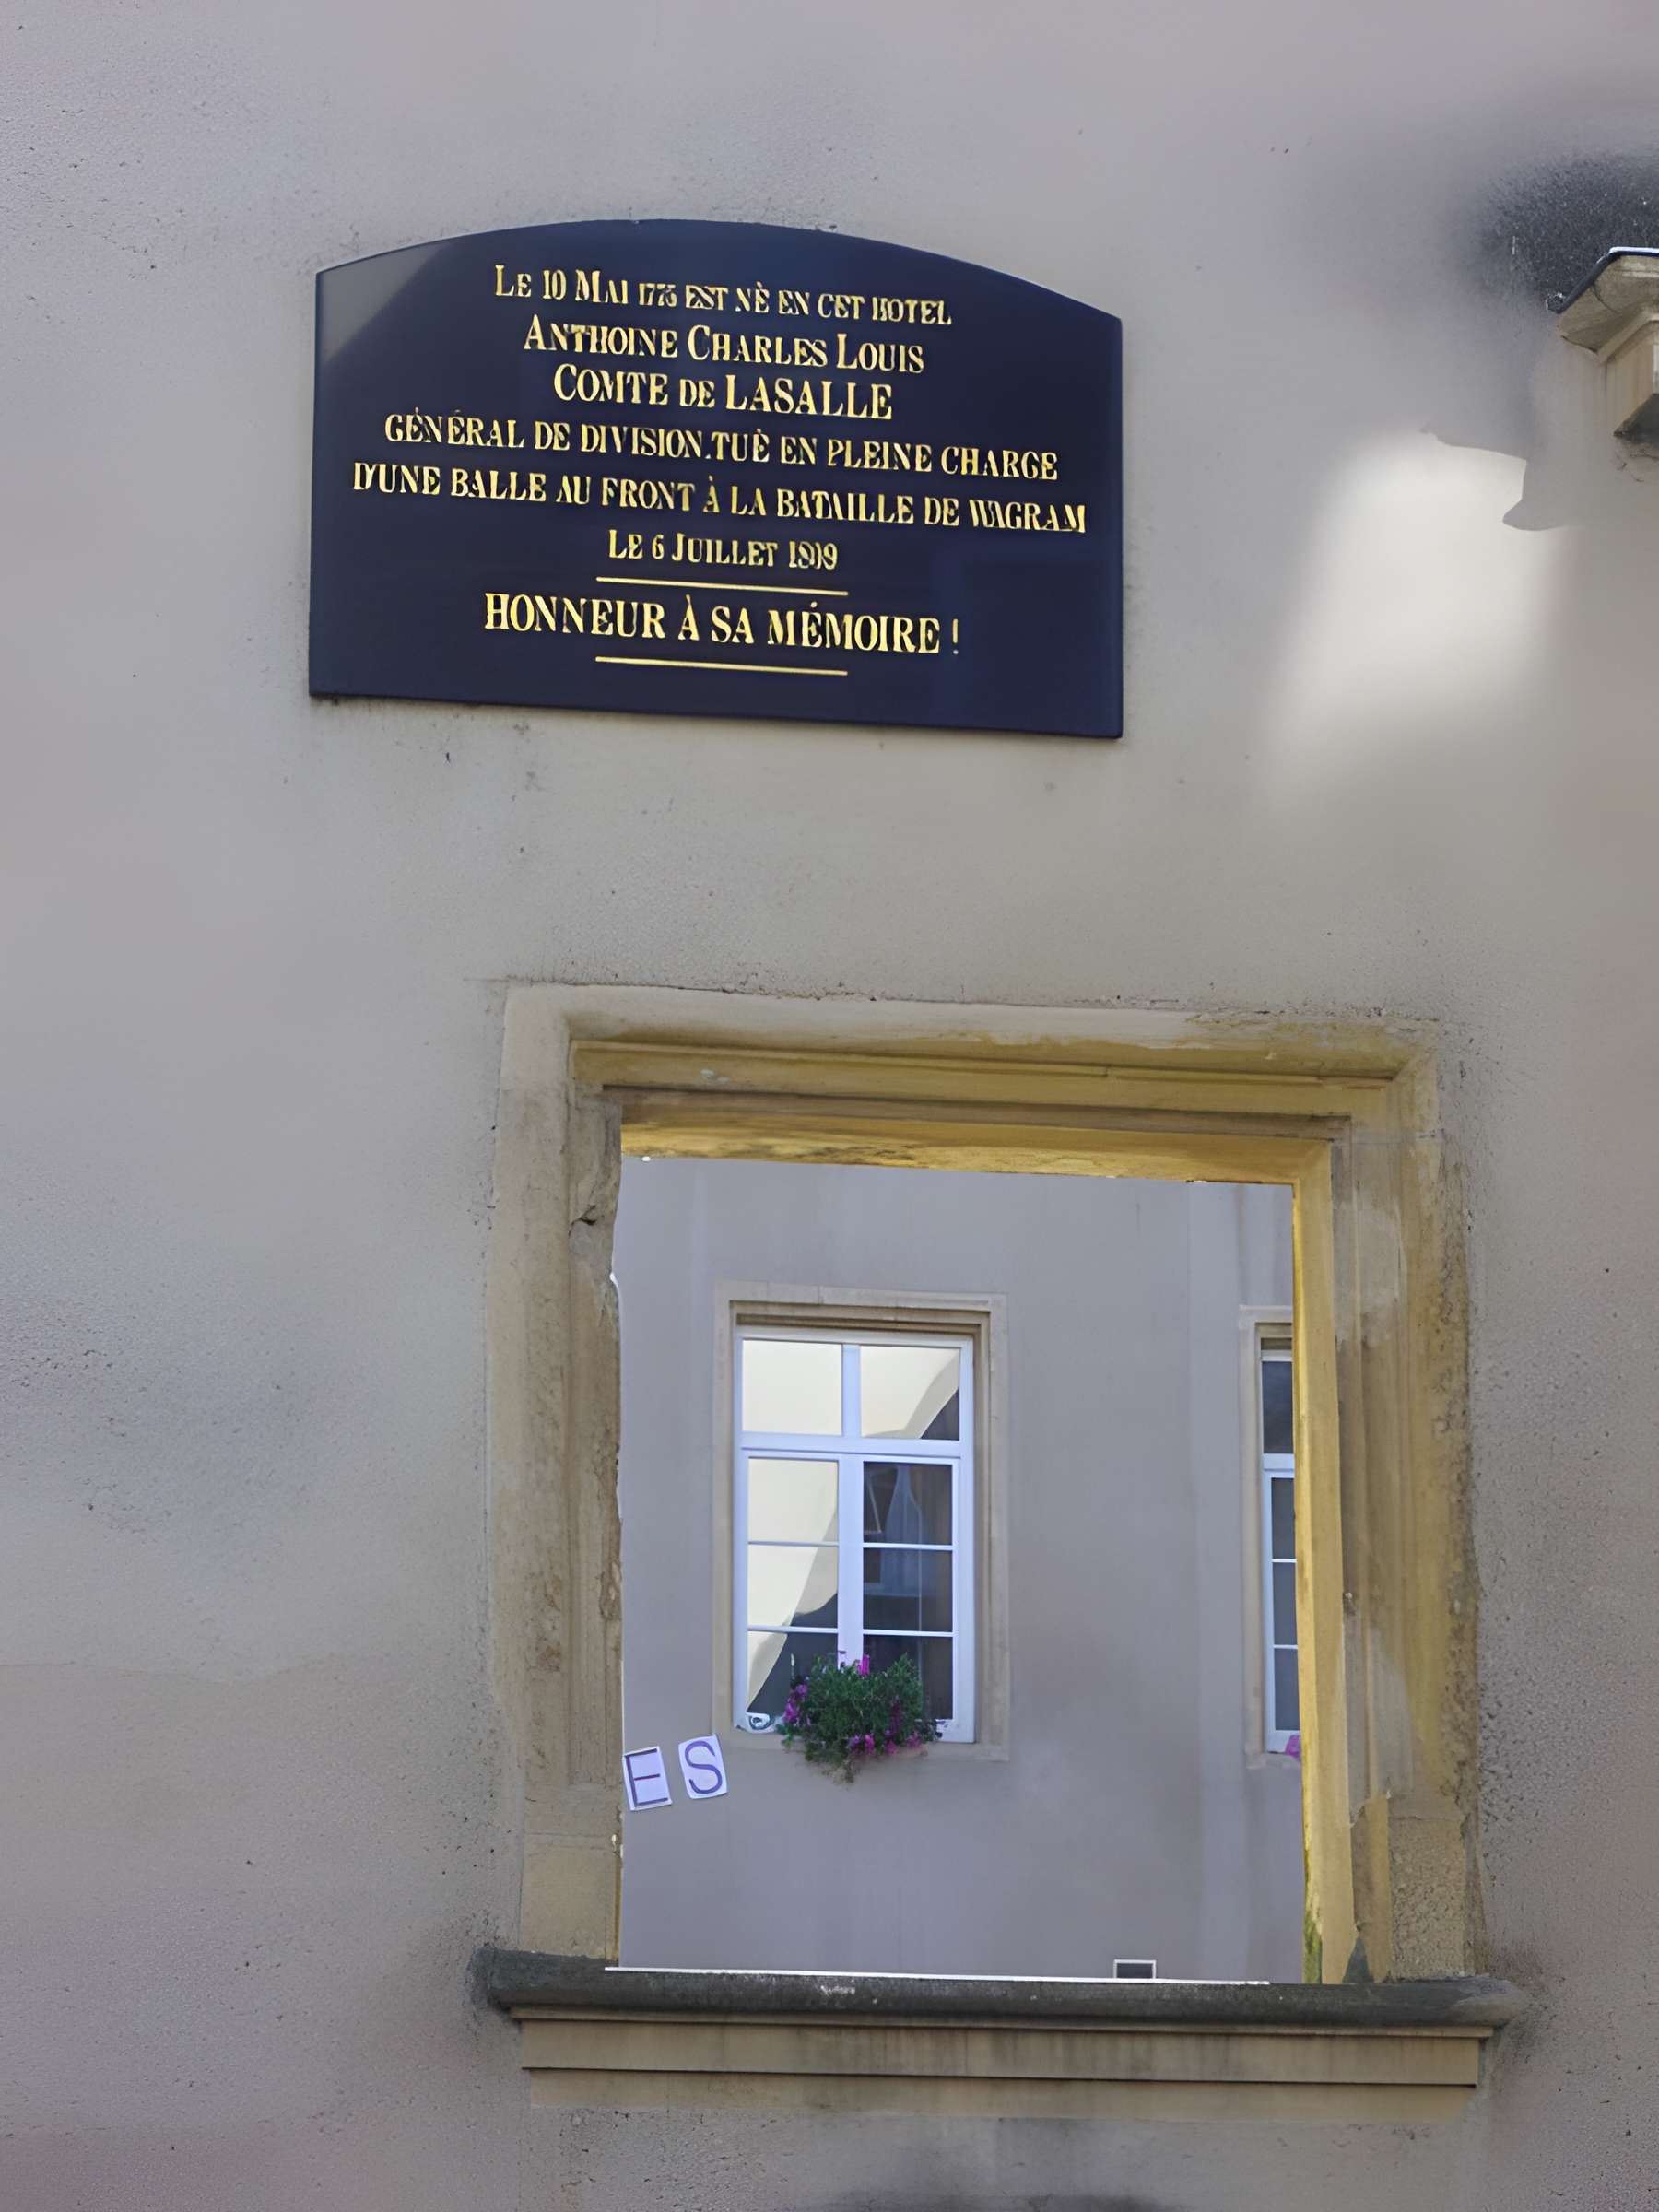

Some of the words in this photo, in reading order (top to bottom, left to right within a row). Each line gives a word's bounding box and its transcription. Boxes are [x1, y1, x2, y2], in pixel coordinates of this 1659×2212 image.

[495, 265, 532, 297] LE
[543, 269, 568, 300] 10
[575, 270, 629, 305] MAI
[685, 285, 729, 311] EST
[778, 289, 811, 315] EN
[818, 293, 865, 320] CET
[523, 313, 679, 359] ANTHOINE
[687, 324, 828, 368] CHARLES
[836, 333, 925, 373] LOUIS
[553, 363, 669, 406] COMTE
[679, 379, 716, 409] DE
[725, 374, 893, 420] LASALLE
[534, 420, 571, 452] DE
[780, 435, 818, 465] EN
[827, 438, 933, 473] PLEINE
[940, 445, 1059, 481] CHARGE
[450, 468, 547, 502] BALLE
[555, 475, 593, 506] AU
[601, 477, 696, 513] FRONT
[731, 485, 767, 517] LA
[776, 488, 914, 524] BATAILLE
[924, 496, 960, 527] DE
[969, 499, 1087, 534] WAGRAM
[608, 529, 644, 559] LE
[651, 535, 665, 559] 6
[671, 532, 779, 566] JUILLET
[484, 591, 666, 640] HONNEUR
[710, 605, 755, 645] SA
